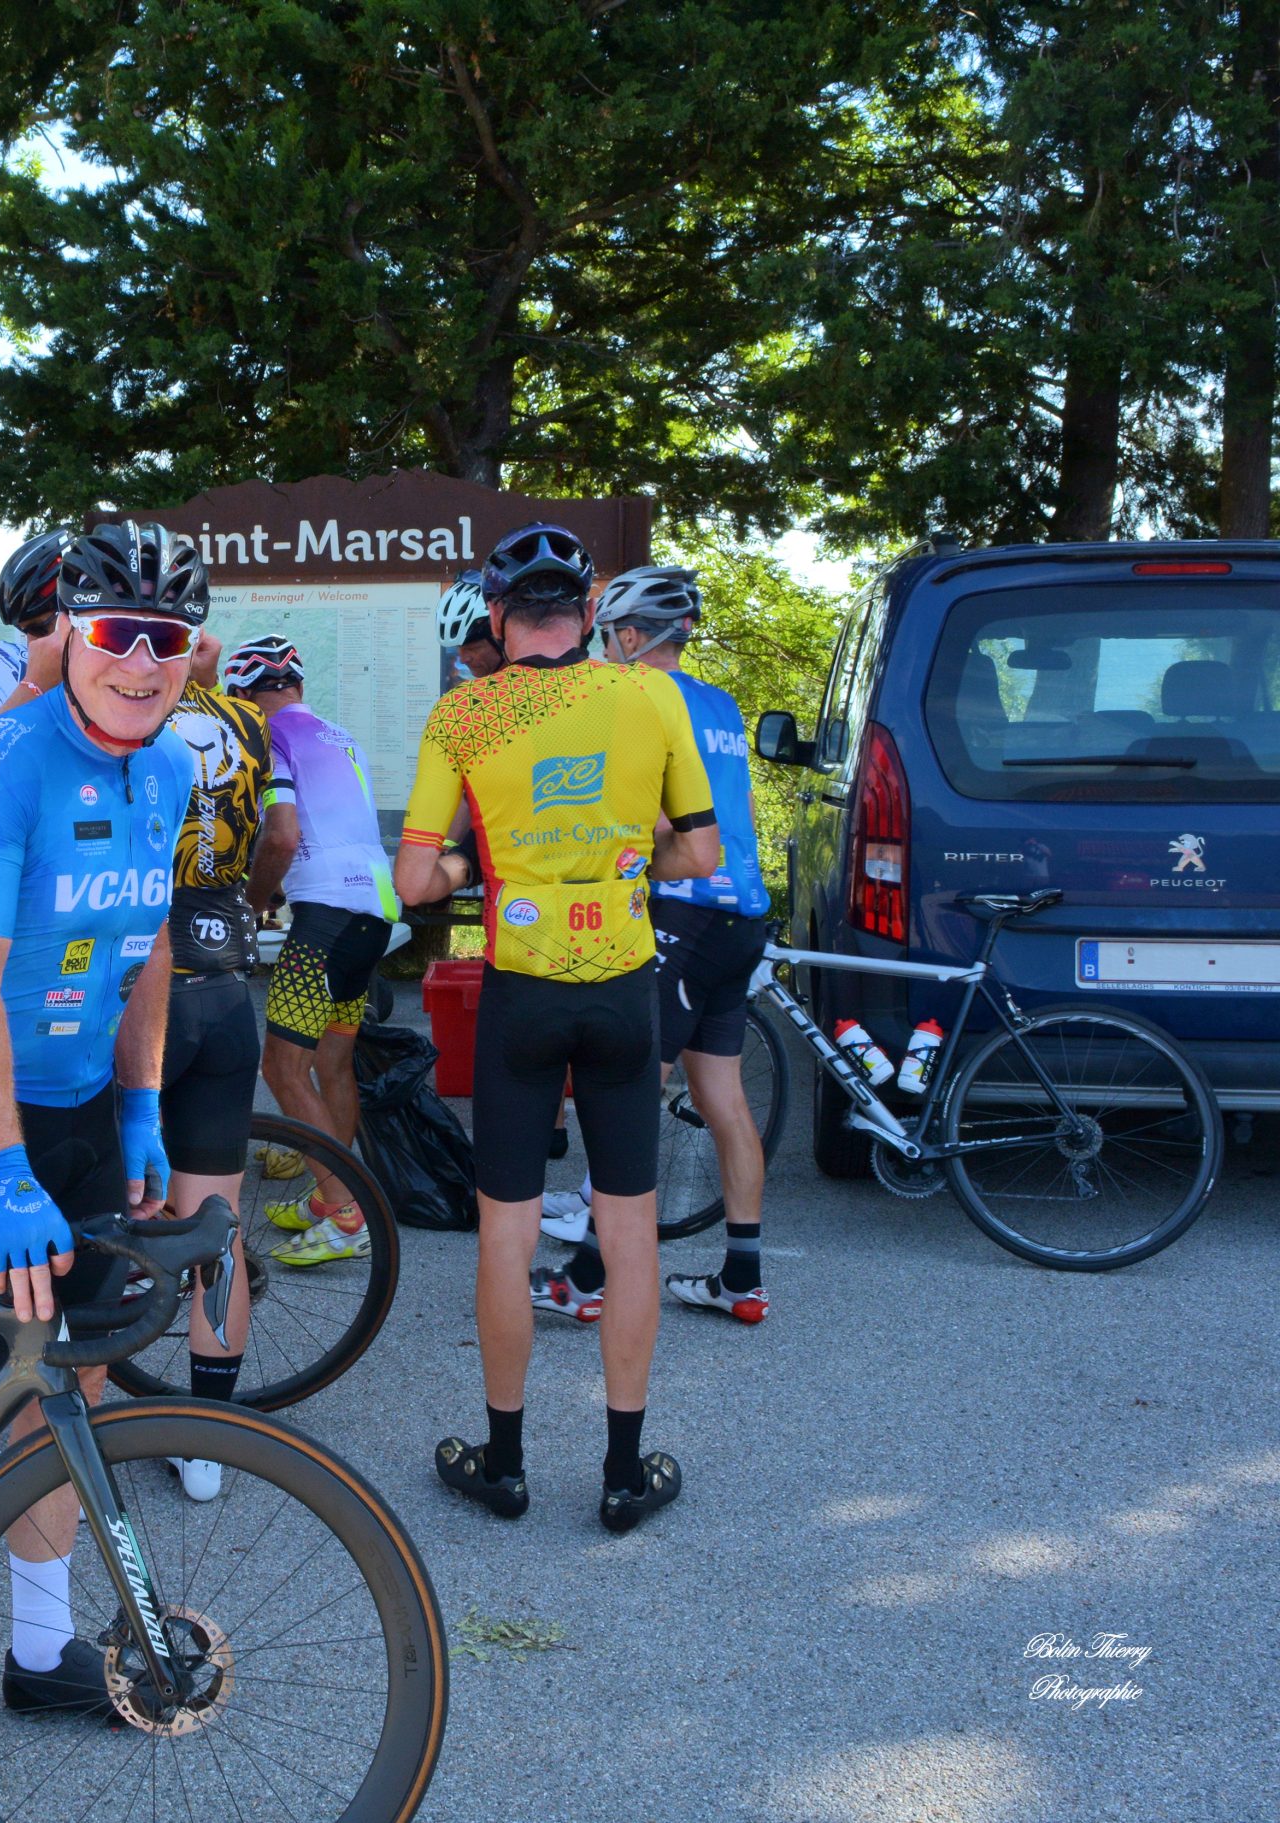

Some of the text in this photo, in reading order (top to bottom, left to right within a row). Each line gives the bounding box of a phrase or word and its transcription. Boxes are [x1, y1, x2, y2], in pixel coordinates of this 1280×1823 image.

[250, 592, 305, 604] Benvingut
[318, 591, 369, 602] Welcome
[198, 792, 216, 878] TEMPLIERS
[511, 823, 641, 847] Saint-Cyprien
[944, 852, 1025, 863] RIFTER
[1150, 879, 1227, 887] PEUGEOT
[569, 902, 602, 931] 66
[195, 918, 224, 941] 78
[1084, 964, 1096, 977] B
[106, 1514, 170, 1658] SPECIALIZED
